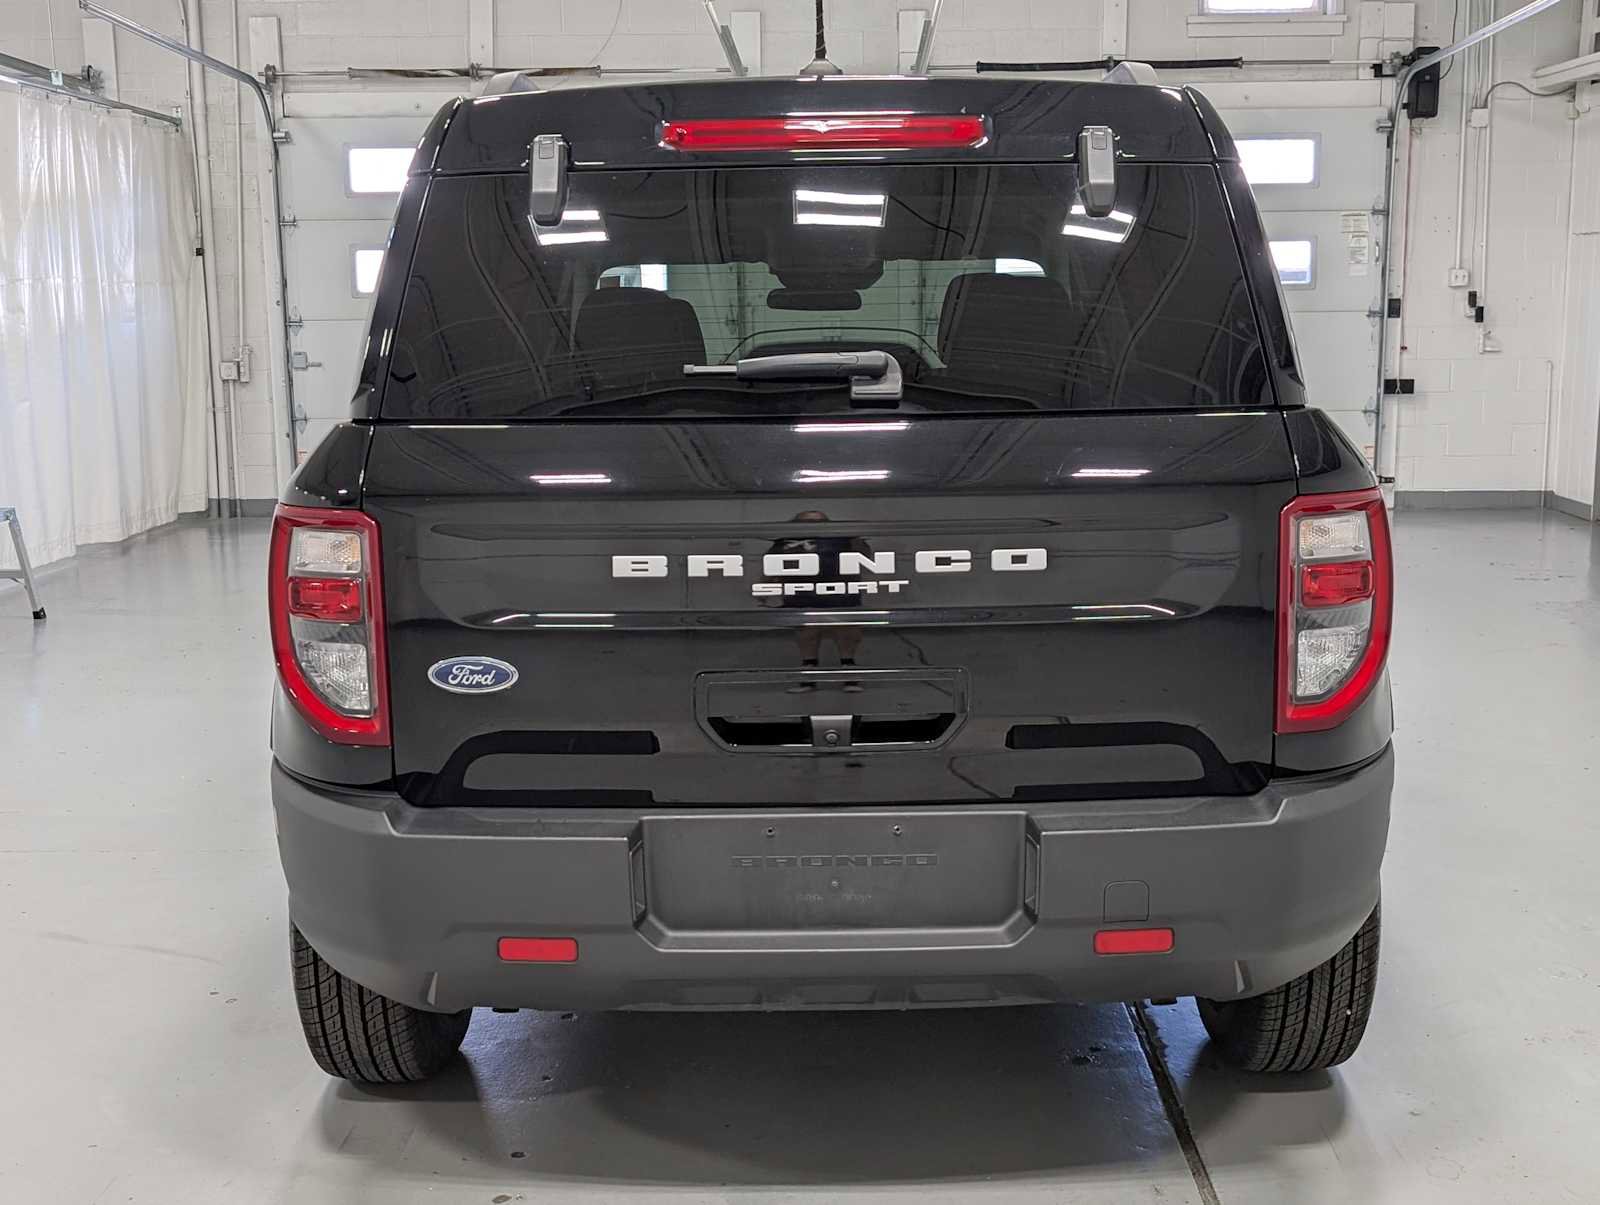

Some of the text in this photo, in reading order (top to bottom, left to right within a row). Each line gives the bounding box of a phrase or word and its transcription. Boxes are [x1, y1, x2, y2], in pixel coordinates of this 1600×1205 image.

[612, 548, 1048, 578] BRONCO
[751, 580, 910, 596] SPORT
[448, 664, 497, 685] Ford
[731, 853, 938, 867] BRONCO
